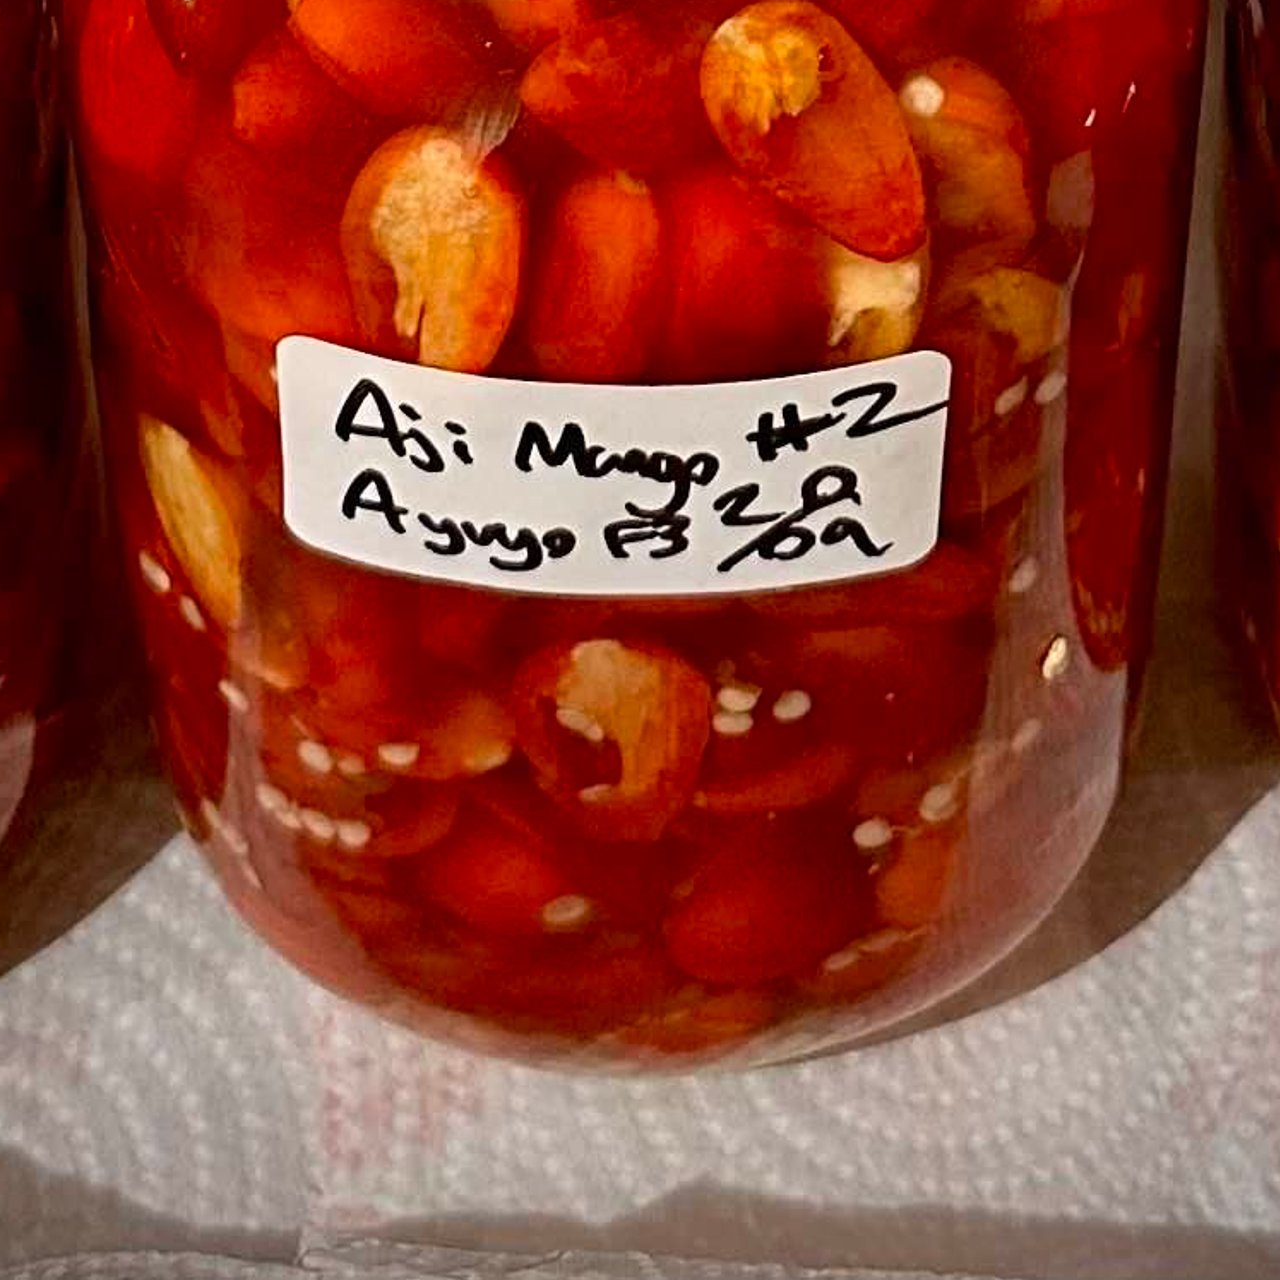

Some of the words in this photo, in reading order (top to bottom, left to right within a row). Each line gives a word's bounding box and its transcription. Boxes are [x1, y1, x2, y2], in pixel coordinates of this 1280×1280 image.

[334, 377, 476, 475] Aji
[515, 421, 720, 516] Mango
[748, 382, 951, 463] #2
